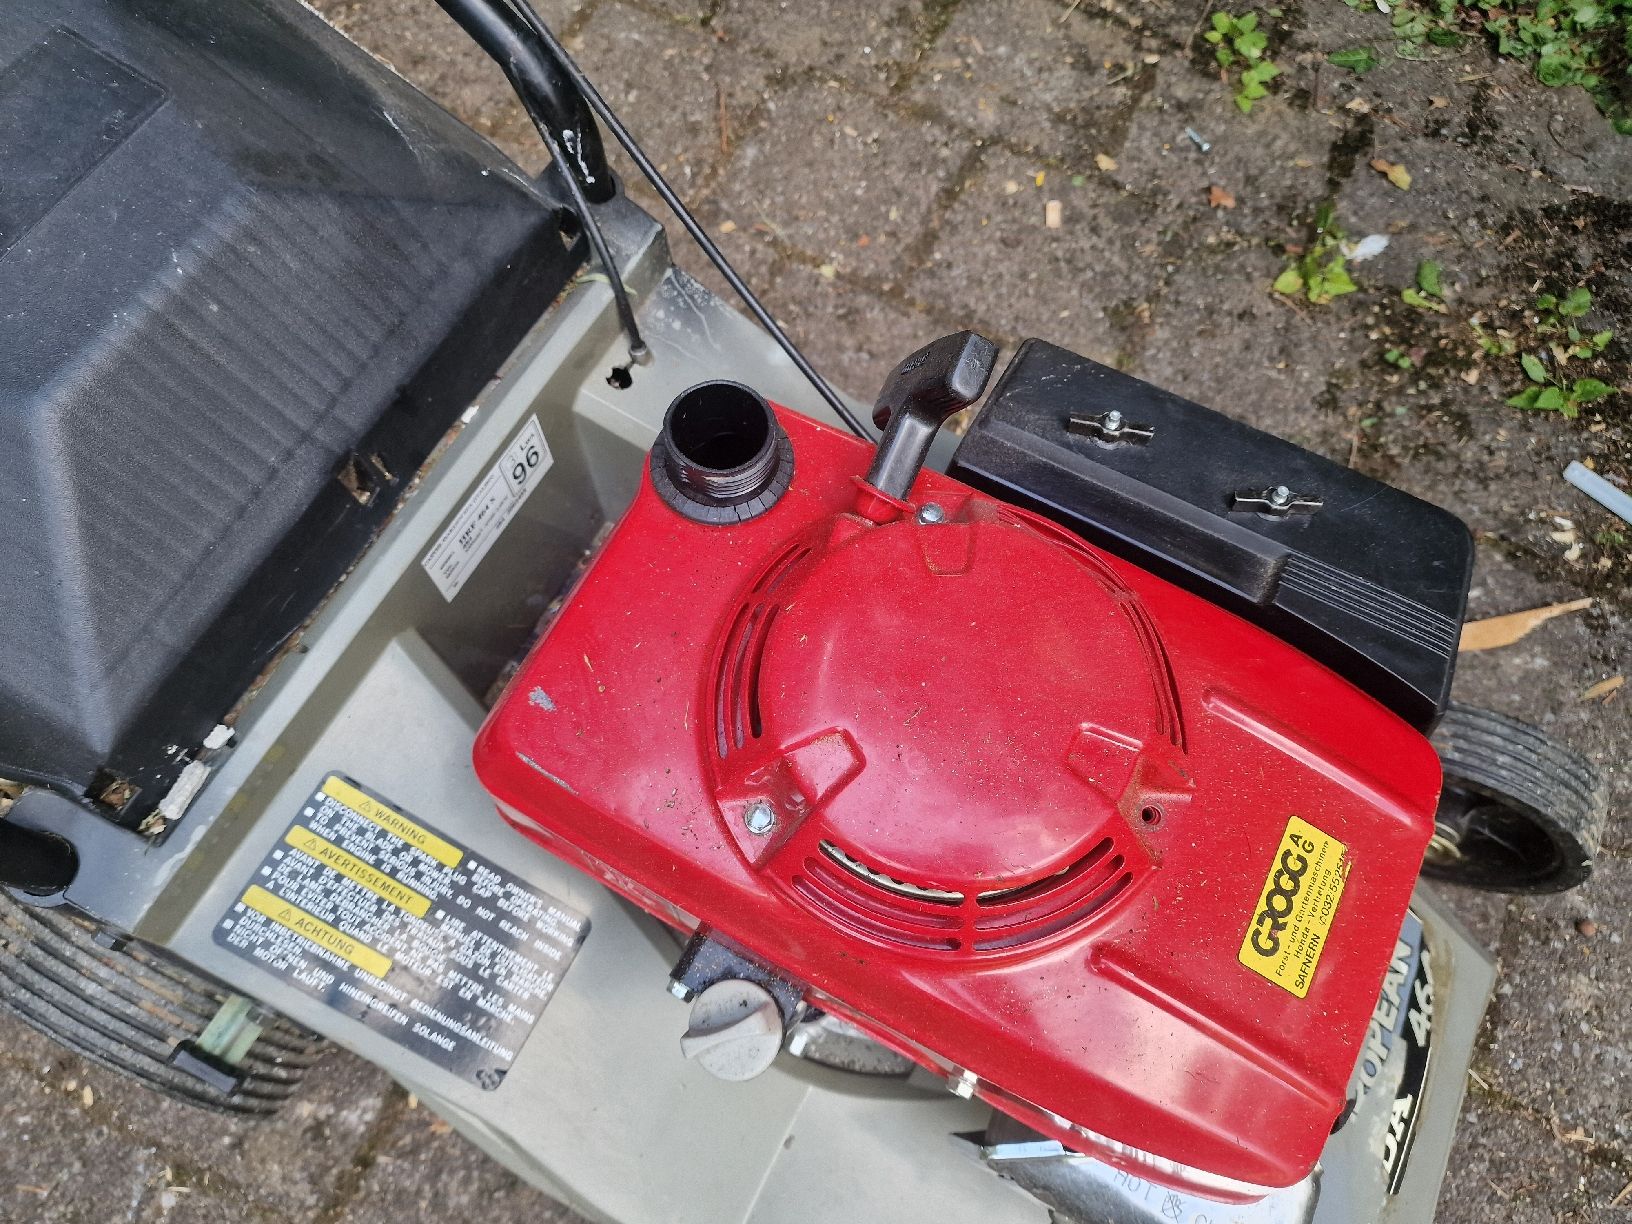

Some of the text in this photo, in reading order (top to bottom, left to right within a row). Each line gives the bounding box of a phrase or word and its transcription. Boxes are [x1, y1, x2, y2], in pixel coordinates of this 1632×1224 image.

[512, 445, 539, 485] 96
[307, 819, 441, 901] WHEN ENGINE IS RUNNING.
[318, 804, 453, 887] ON THE BLADE OR MOWER.
[373, 808, 428, 845] WARNING
[276, 862, 292, 876] DE
[393, 928, 409, 942] LA
[313, 812, 329, 826] TO
[331, 822, 375, 852] PREVENT
[376, 848, 418, 877] SERIOUS
[455, 894, 472, 909] DO
[474, 905, 496, 923] NOT
[497, 918, 529, 942] REACH
[532, 938, 563, 961] INSIDE
[318, 845, 414, 905] AVERTISSEMENT
[322, 796, 575, 947] DISCONNECT THE SPARK PLUG CAP BEFORE WORKING
[470, 872, 505, 897] BEFORE
[475, 864, 582, 931] READ OWNER'S MANUAL
[1251, 849, 1308, 957] GROGG
[237, 914, 306, 957] DURCHLESEN.
[270, 870, 300, 892] POUR
[334, 906, 362, 927] TOUT
[361, 921, 408, 953] ACCIDENT
[408, 948, 423, 961] NE
[425, 957, 445, 974] PAS
[446, 968, 484, 996] METTRE
[485, 990, 505, 1007] LES
[506, 1002, 536, 1025] MAINS
[281, 854, 531, 1001] AVANT D'EFFECTUER DES TRAVAUX SOUS LE CARTER
[287, 846, 321, 870] AVANT
[321, 865, 338, 880] DE
[339, 876, 379, 903] METTRE
[380, 899, 397, 914] LA
[397, 909, 446, 941] TONDEUSE
[457, 943, 492, 968] GAZON
[492, 962, 508, 977] EN
[294, 916, 355, 956] ACHTUNG
[438, 921, 477, 949] MANUEL
[477, 943, 493, 958] DE
[443, 913, 554, 982] LIRE ATTENTIVEMENT LE
[1290, 924, 1300, 944] und
[226, 931, 249, 949] DER
[252, 945, 289, 971] MOTOR
[232, 923, 265, 946] NICHT
[311, 966, 336, 985] UND
[338, 980, 409, 1026] HINEINGREIFEN
[411, 1021, 457, 1053] SOLANGE
[243, 906, 514, 1062] VOR INBETRIEBNAHME UNBEDINGT BEDIENUNGSANLEITUNG
[336, 919, 373, 945] QUAND
[375, 940, 390, 954] LE
[392, 950, 433, 978] MOTEUR
[435, 974, 455, 990] EST
[457, 986, 474, 1001] EN
[1295, 933, 1321, 989] SAFNERN
